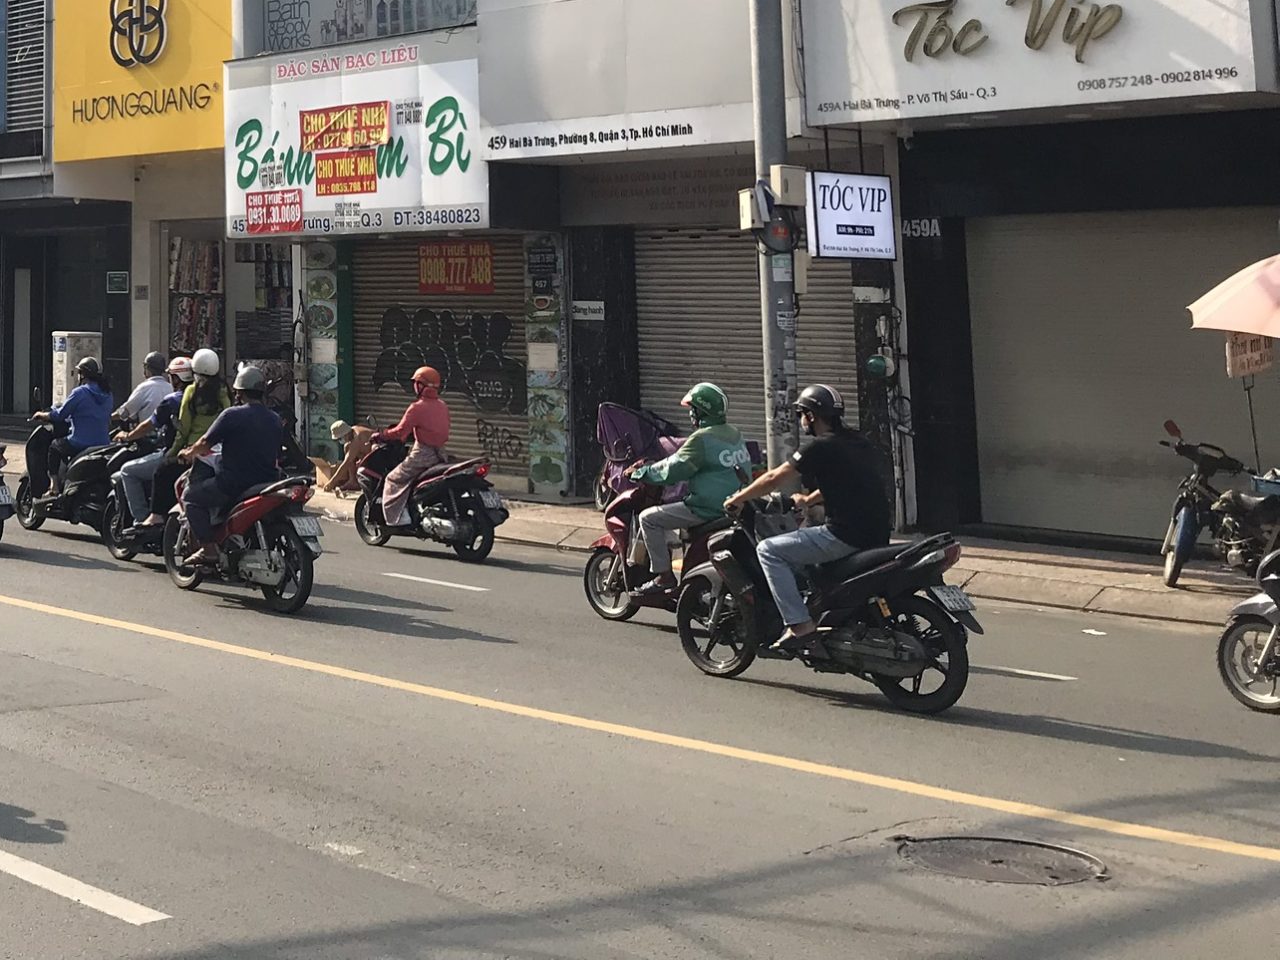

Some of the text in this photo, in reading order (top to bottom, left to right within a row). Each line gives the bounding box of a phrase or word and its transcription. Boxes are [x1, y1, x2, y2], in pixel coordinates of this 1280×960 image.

[267, 34, 311, 51] Works
[277, 44, 419, 81] ĐẶC SẢN BẠC LIÊU
[1077, 78, 1106, 91] 0908
[1108, 76, 1128, 88] 757
[1131, 74, 1153, 86] 248
[1161, 71, 1191, 84] 0902
[1194, 69, 1213, 81] 814
[1214, 66, 1238, 79] 996
[817, 102, 841, 113] 459A
[843, 100, 859, 111] Hai
[860, 98, 871, 110] Bà
[874, 97, 900, 110] Trưng
[907, 95, 915, 105] P.
[916, 92, 931, 104] Võ
[932, 91, 948, 104] Thị
[950, 89, 968, 101] Sáu
[303, 102, 387, 134] CHO THUÊ NHÀ
[425, 96, 471, 176] Bì
[487, 135, 507, 150] 459
[509, 137, 522, 149] Hai
[523, 134, 533, 148] Bà
[558, 132, 588, 148] Phường
[598, 128, 620, 144] Quận
[642, 124, 653, 138] Hồ
[655, 123, 670, 137] Chí
[671, 122, 693, 136] Minh
[317, 158, 333, 179] CHO
[335, 153, 356, 177] THUÊ
[357, 152, 375, 175] NHÀ
[248, 193, 263, 206] CHO
[264, 191, 283, 205] THUÊ
[317, 184, 325, 194] LH
[819, 178, 887, 213] TÓC VIP
[248, 203, 301, 225] 0931.30.0089
[303, 216, 334, 232] rưng,
[361, 212, 383, 227] Q.3
[902, 219, 941, 237] 459A
[420, 243, 492, 257] CHO THUÊ NHÀ
[420, 258, 492, 285] 0908.777.488
